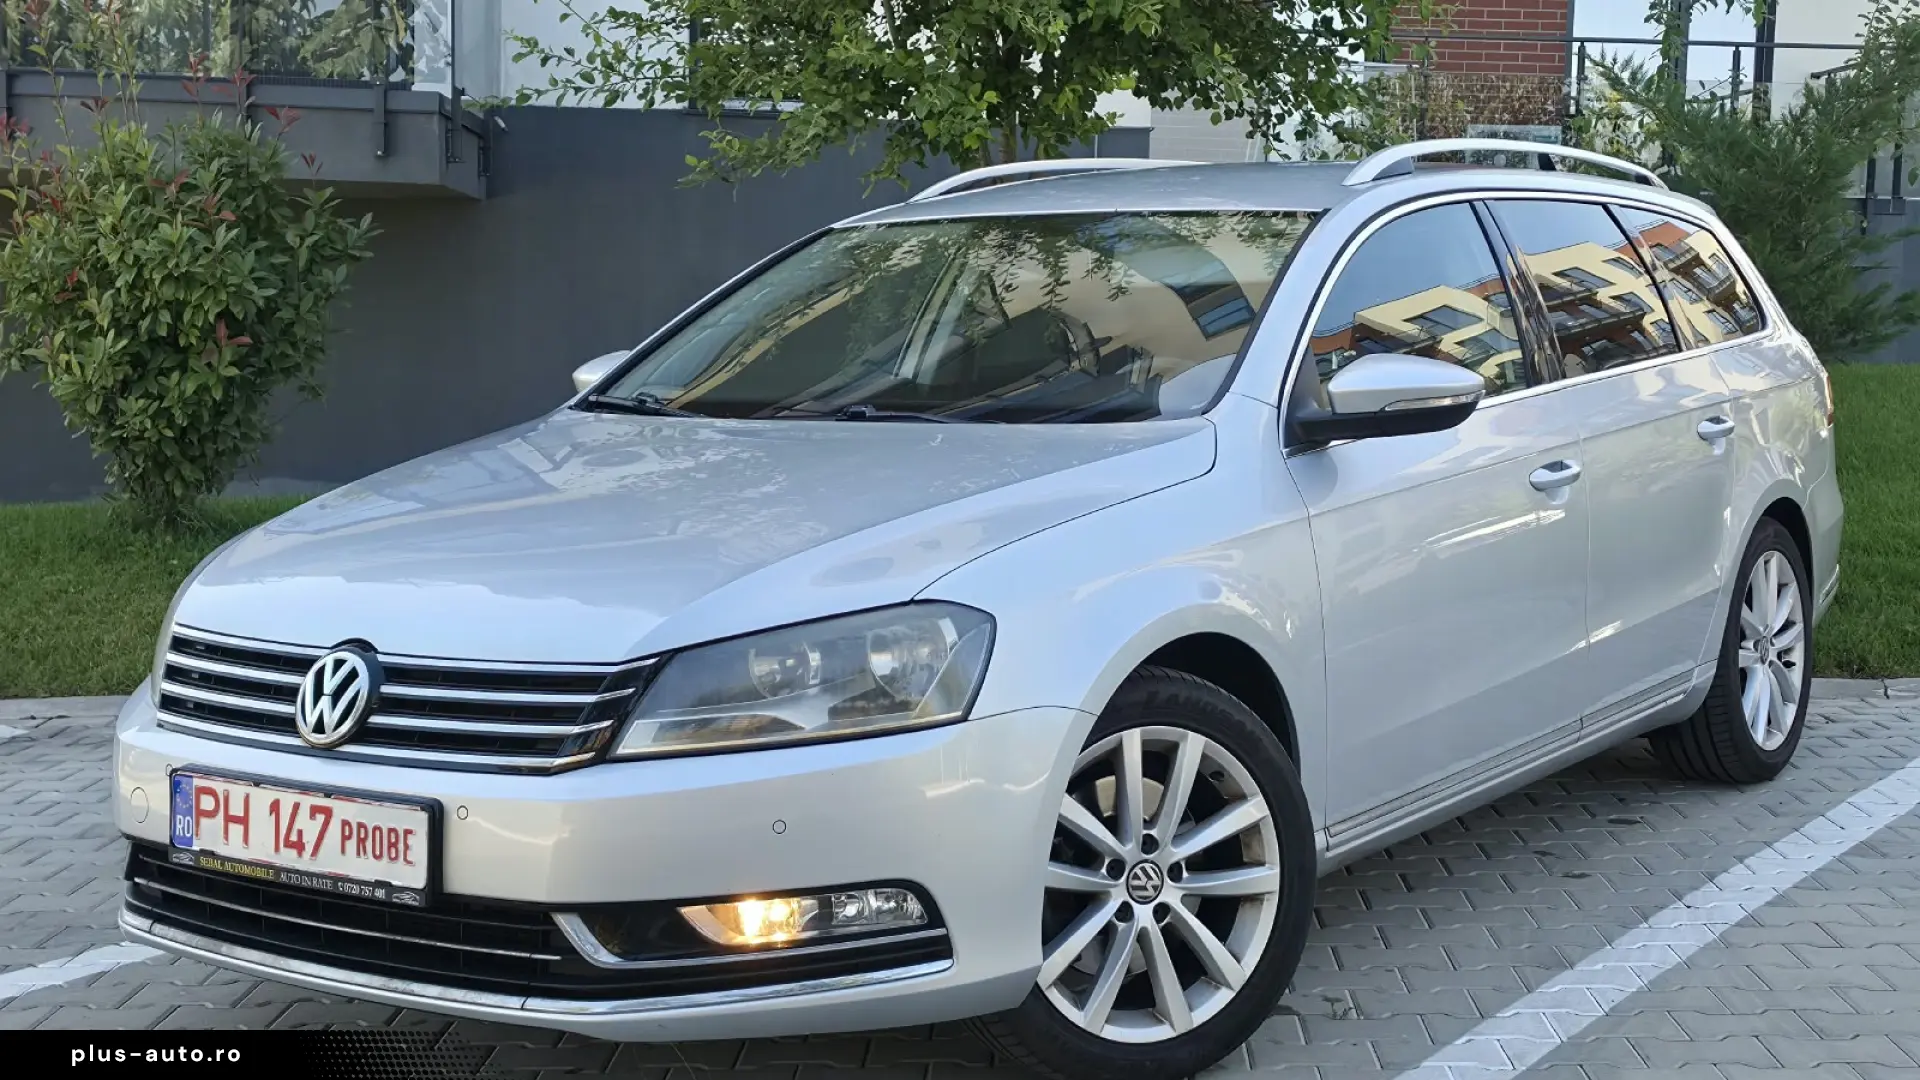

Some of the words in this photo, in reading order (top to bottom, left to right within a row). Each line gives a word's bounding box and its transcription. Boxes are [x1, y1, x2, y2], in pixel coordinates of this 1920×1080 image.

[175, 814, 193, 837] RO
[194, 784, 250, 849] PH
[268, 798, 334, 861] 147
[340, 818, 417, 867] PROBE
[224, 860, 275, 879] AUTOMOBILE
[280, 871, 301, 886] AUTO
[301, 876, 312, 888] IN
[312, 877, 333, 891] RATE
